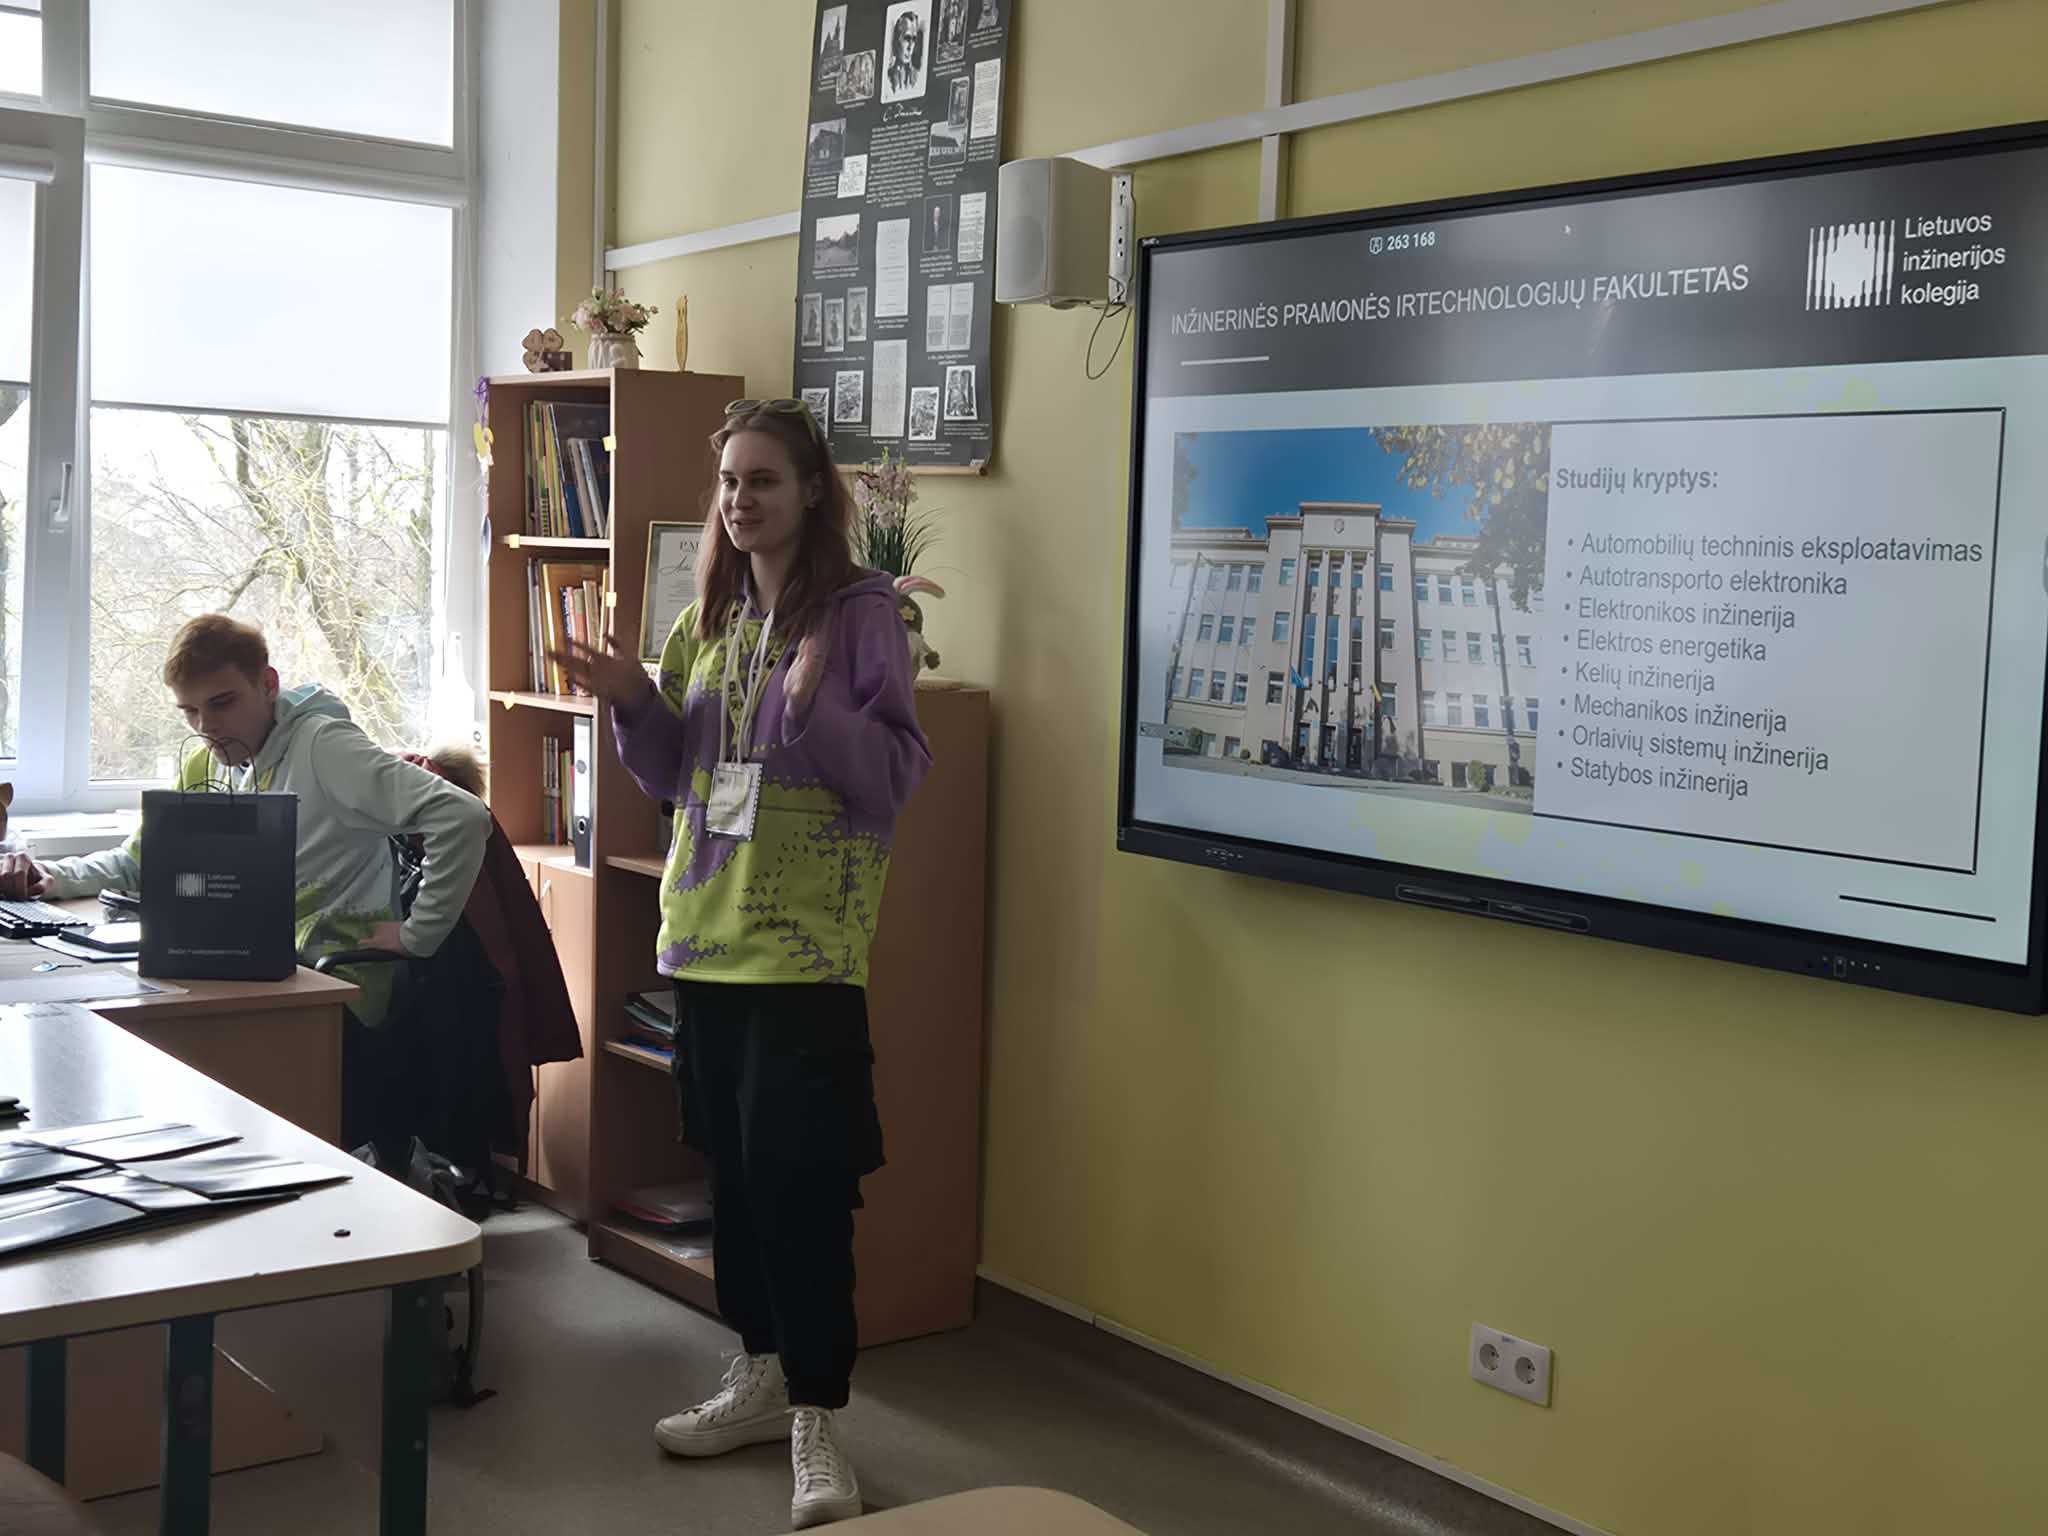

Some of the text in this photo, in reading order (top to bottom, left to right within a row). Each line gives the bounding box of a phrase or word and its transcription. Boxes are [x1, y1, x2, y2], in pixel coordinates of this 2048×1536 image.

[1387, 231, 1435, 251] 263 168
[1905, 212, 1992, 239] Lietuvos
[1903, 244, 2006, 273] inžinerijos
[1171, 303, 1278, 336] INŽINERINĖS
[1283, 292, 1389, 328] PRAMONĖS
[1593, 264, 1749, 304] FAKULTETAS
[1900, 282, 1980, 308] kolegija
[1556, 467, 1718, 494] Studijų kryptys:
[1581, 533, 1982, 565] Automobilių techninis eksploatavimas
[1579, 565, 1847, 595] Autotransporto elektronika
[1578, 598, 1795, 632] Elektronikos inžinerija
[1577, 629, 1766, 664] Elektros energetika
[1576, 662, 1715, 696] Kelių inžinerija
[1574, 694, 1786, 736] Mechanikos inžinerija
[1572, 725, 1829, 774] Orlaivių sistemų inžinerija
[1570, 757, 1749, 799] Statybos inžinerija
